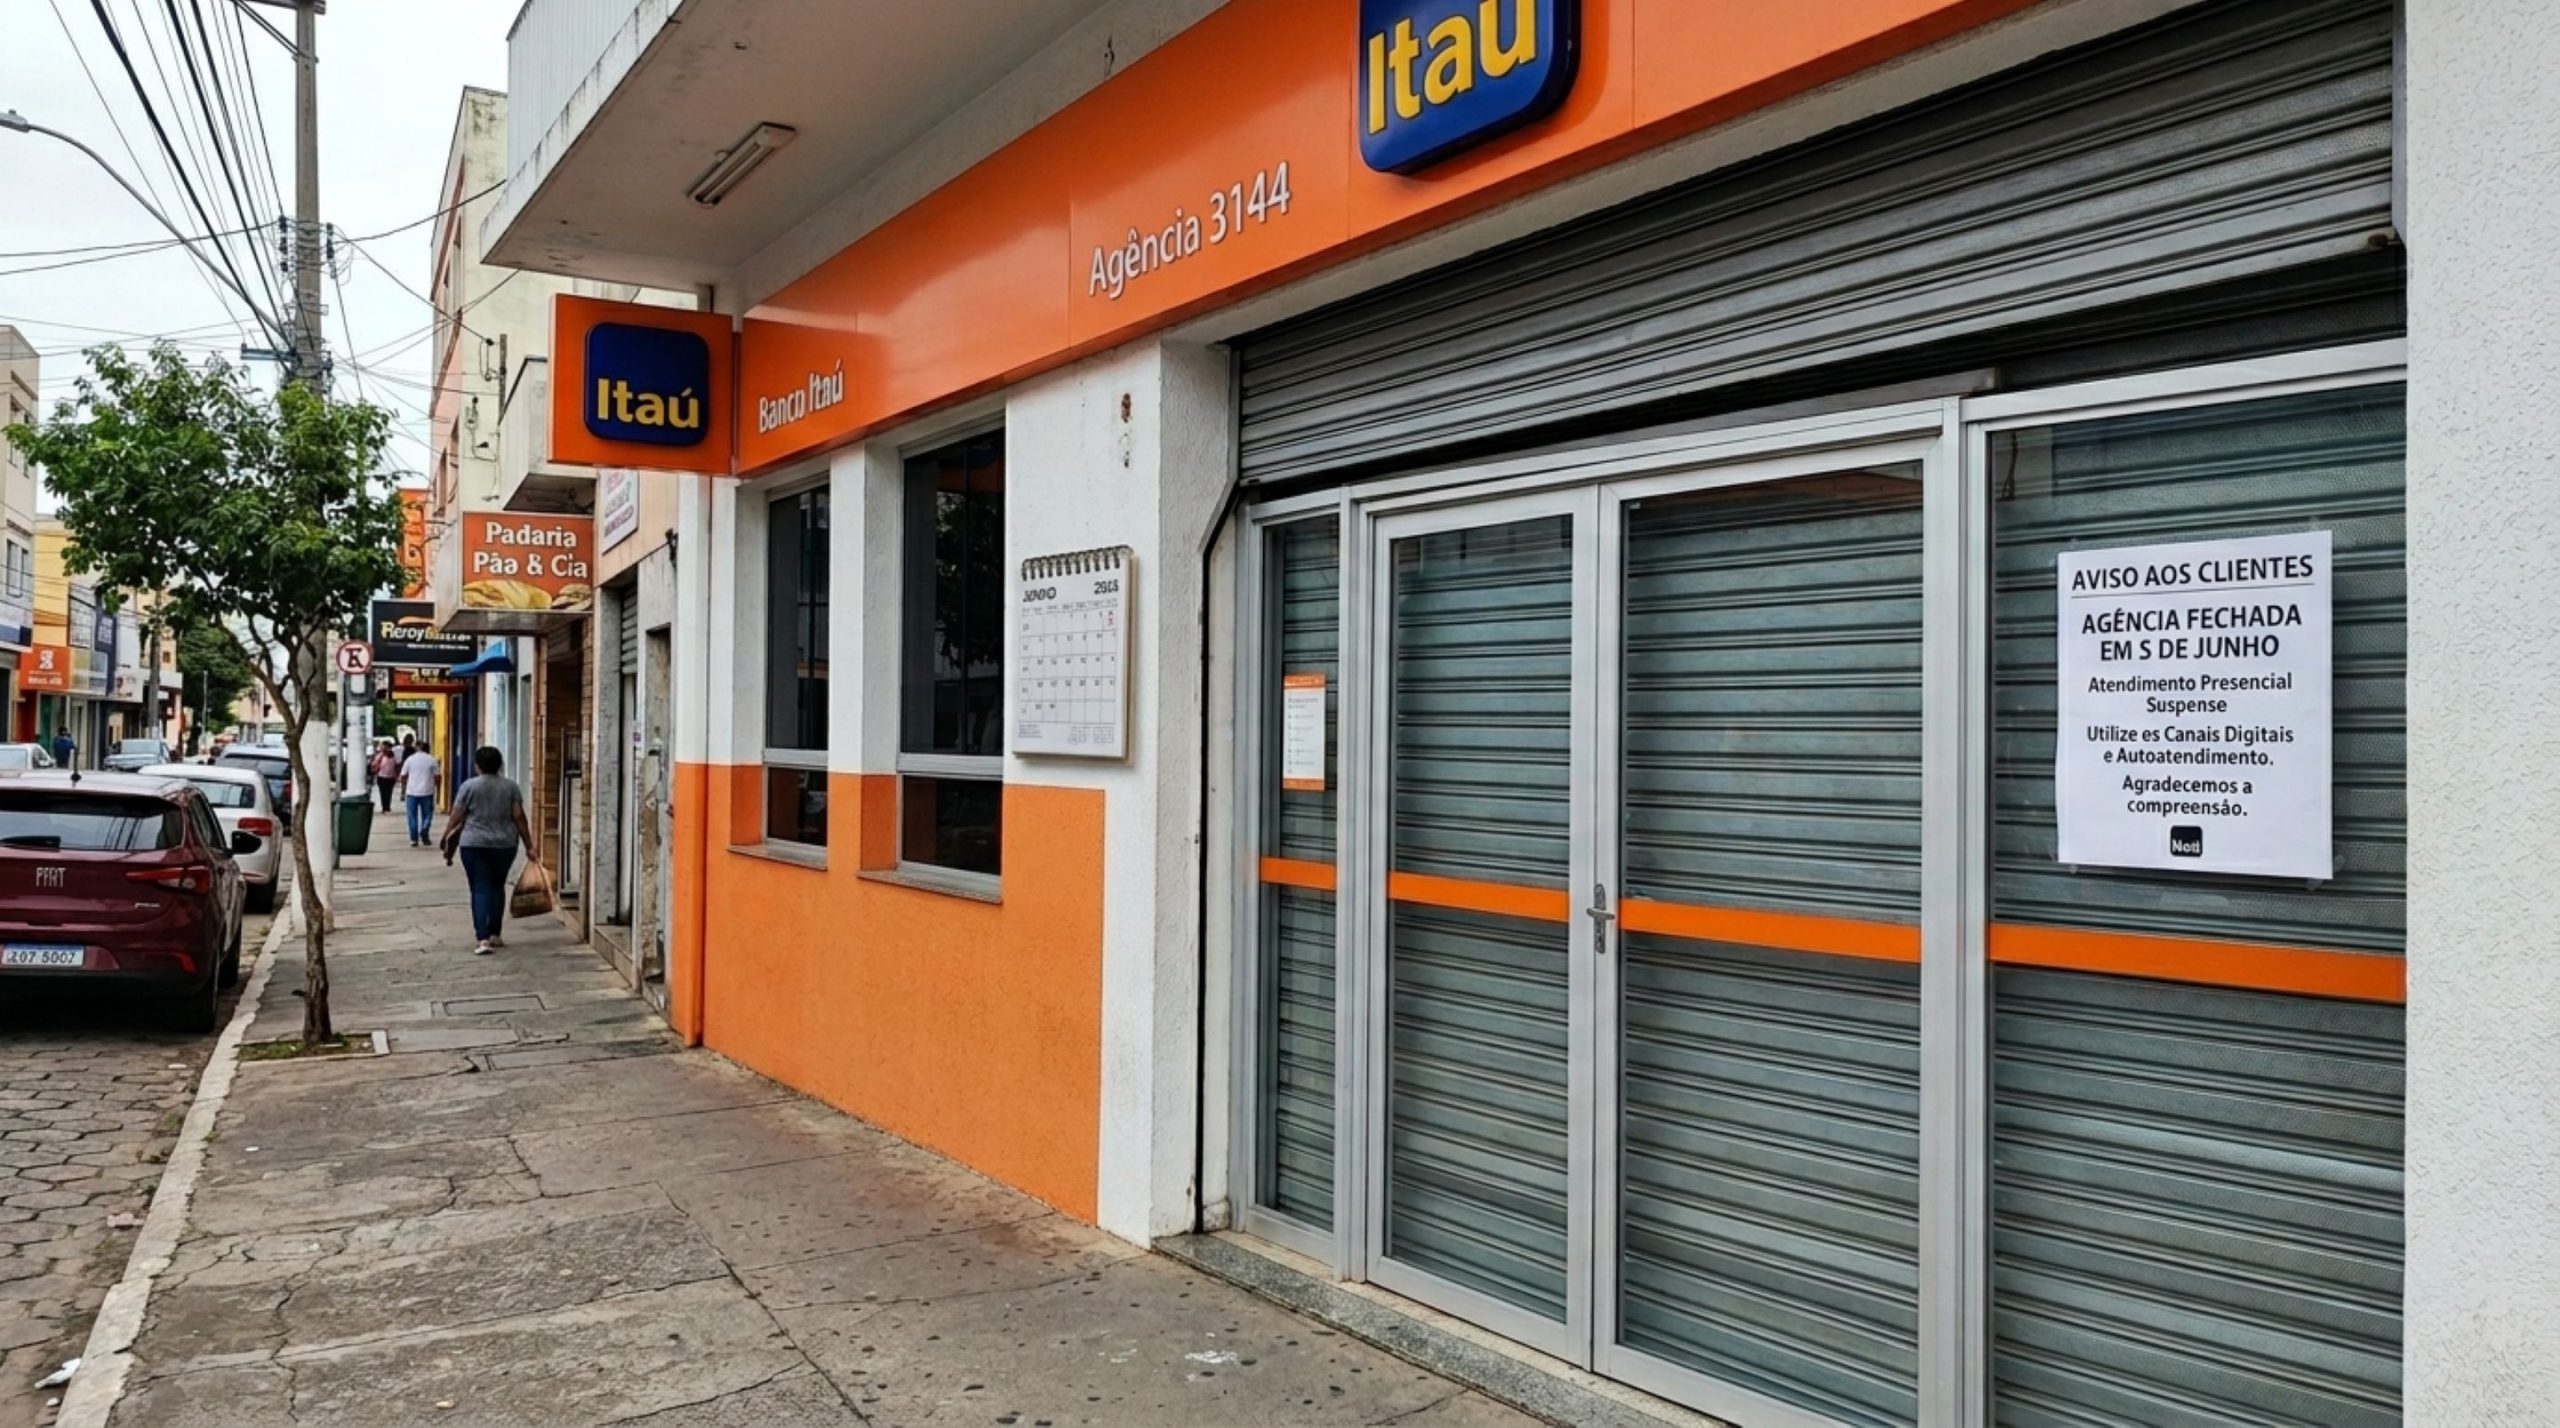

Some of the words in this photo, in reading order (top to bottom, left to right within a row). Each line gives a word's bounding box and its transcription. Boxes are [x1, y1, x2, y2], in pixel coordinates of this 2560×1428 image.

[1088, 208, 1200, 299] Agência
[1209, 161, 1290, 243] 3144
[598, 378, 699, 428] Itaú
[759, 389, 805, 433] Banco
[808, 359, 843, 411] Itaú
[486, 521, 577, 547] Padaria
[527, 553, 543, 575] &
[551, 553, 587, 578] Cia
[2072, 566, 2138, 591] AVISO
[2144, 563, 2191, 586] AOS
[2198, 555, 2313, 582] CLIENTES
[2187, 604, 2302, 629] FECHADA
[2100, 640, 2132, 661] EM
[2159, 638, 2188, 659] DE
[2194, 635, 2279, 658] JUNHO
[2088, 676, 2196, 693] Atendimento
[2200, 672, 2292, 690] Presencial
[2087, 726, 2138, 742] Utilize
[2164, 725, 2220, 742] Canais
[2224, 725, 2294, 746] Digitais
[2103, 750, 2113, 763] e
[2116, 747, 2274, 766] Autoatendimento.
[2122, 774, 2238, 796] Agradecemos
[2242, 781, 2253, 794] a
